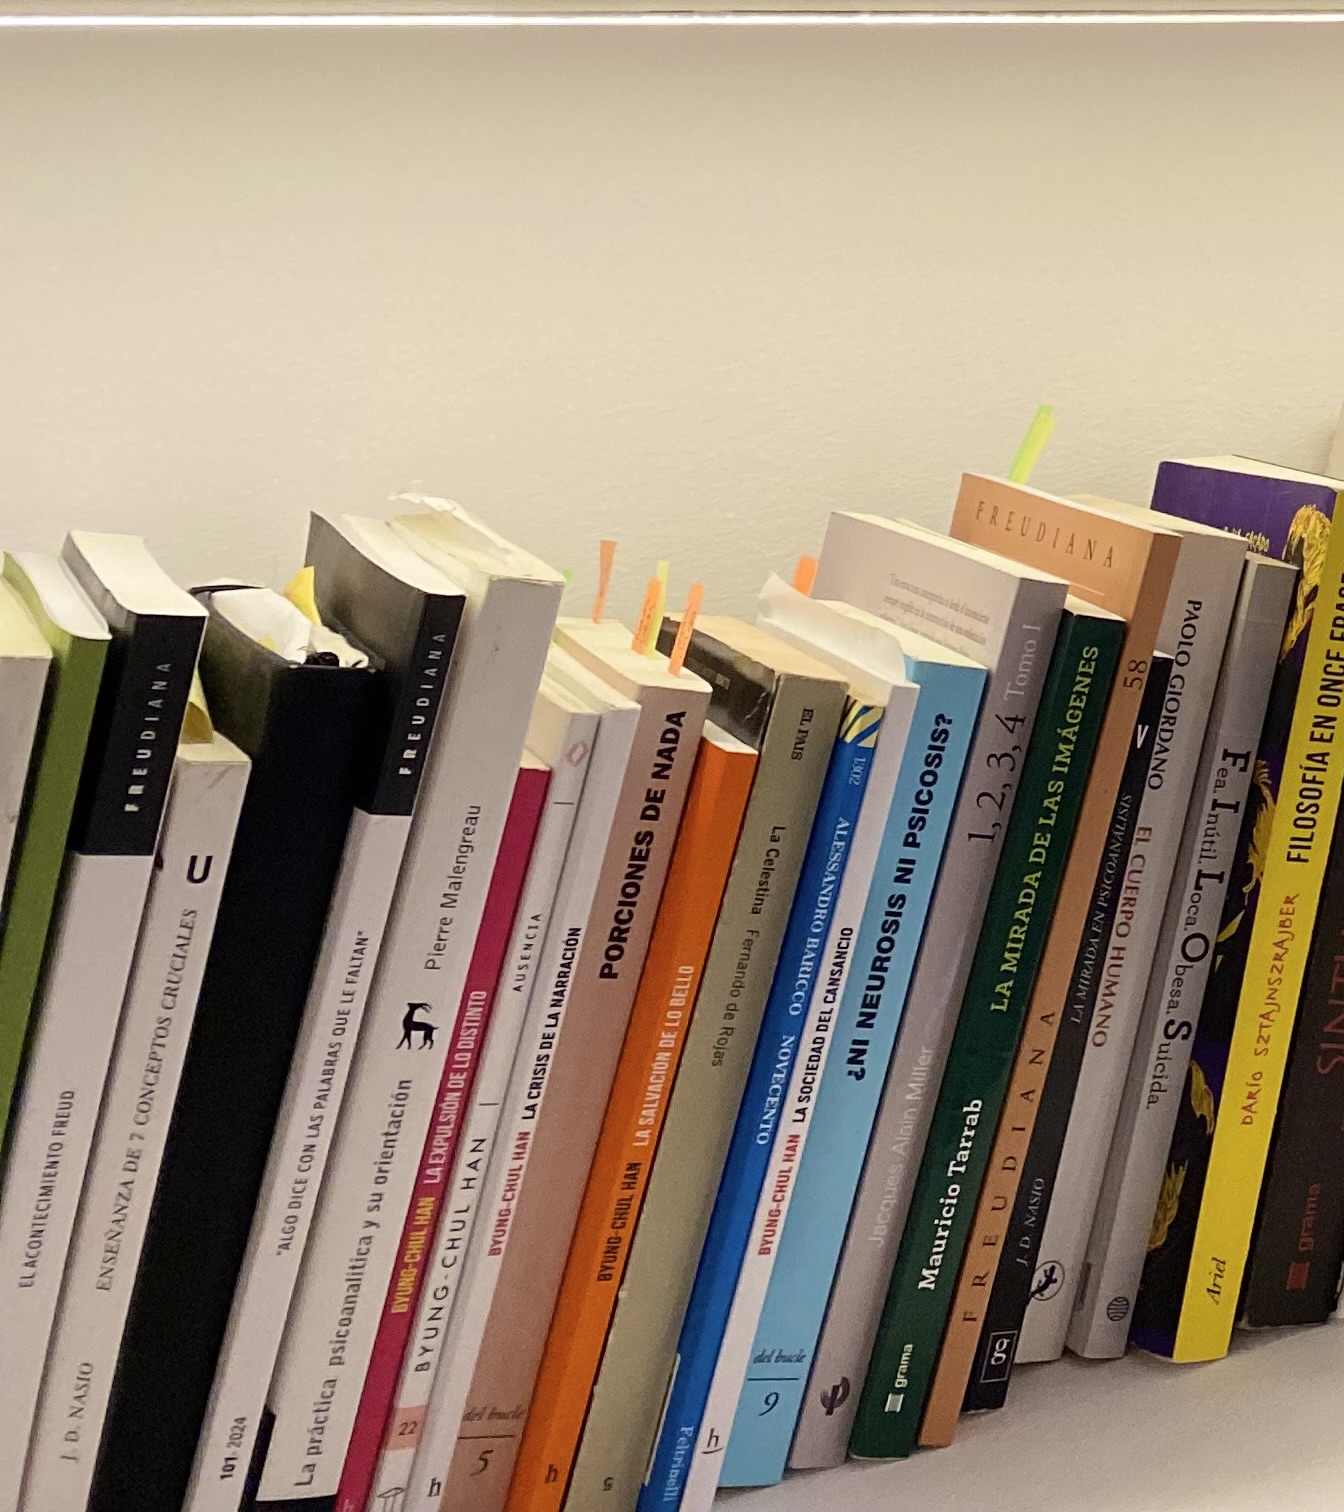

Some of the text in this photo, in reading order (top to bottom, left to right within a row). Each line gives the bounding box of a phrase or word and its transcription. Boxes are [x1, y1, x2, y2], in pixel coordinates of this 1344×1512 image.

[124, 663, 170, 811] FREUDIANA
[1285, 751, 1330, 863] FILOSOFÍA
[1309, 714, 1337, 743] EN
[423, 805, 480, 969] Pierre Malengreau
[598, 711, 686, 979] PORCIONES DE NADA
[845, 713, 952, 1080] ¿NI NEUROSIS NI PSICOSIS?
[990, 646, 1098, 1011] LA MIRADA DE LAS IMÁGENES
[18, 1090, 74, 1287] EL ACONTECIMIENTO FREUD
[367, 1192, 383, 1212] su
[373, 1079, 412, 1184] orientación
[917, 1099, 982, 1290] Mauricio Tarrab
[362, 1220, 380, 1228] y
[1206, 1256, 1226, 1305] Ariel
[293, 1463, 316, 1486] La
[306, 1378, 337, 1456] práctica
